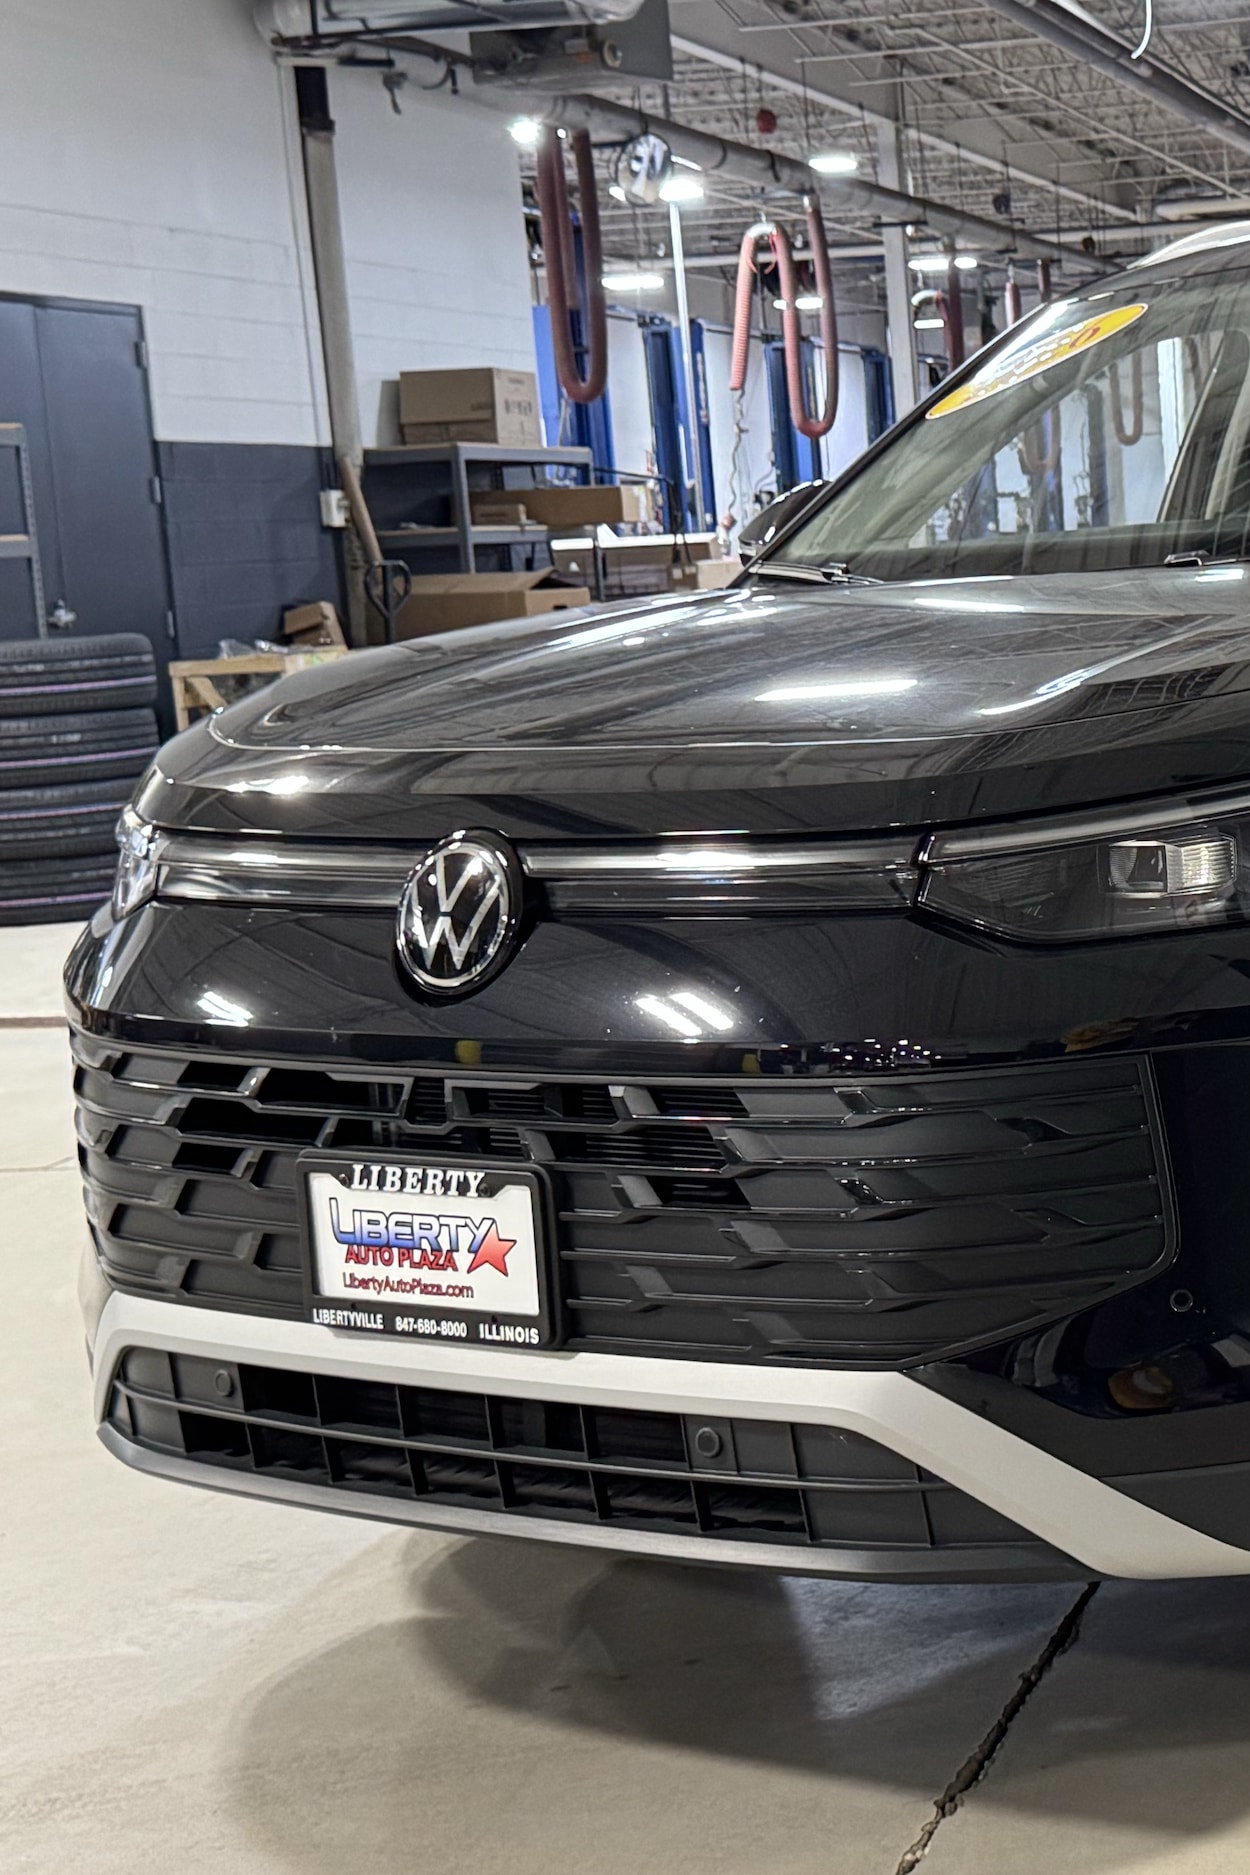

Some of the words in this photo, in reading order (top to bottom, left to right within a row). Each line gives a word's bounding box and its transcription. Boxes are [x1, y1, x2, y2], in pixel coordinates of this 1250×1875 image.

[350, 1163, 485, 1198] LIBERTY
[329, 1197, 496, 1254] LIBERTY
[344, 1244, 395, 1267] AUTO
[399, 1247, 459, 1272] PLAZA
[342, 1271, 475, 1299] LibertyAutoPlaza.com
[312, 1307, 385, 1330] LIBERTYVILLE
[395, 1316, 468, 1338] 847-680-8000
[479, 1322, 540, 1345] ILLINOIS
